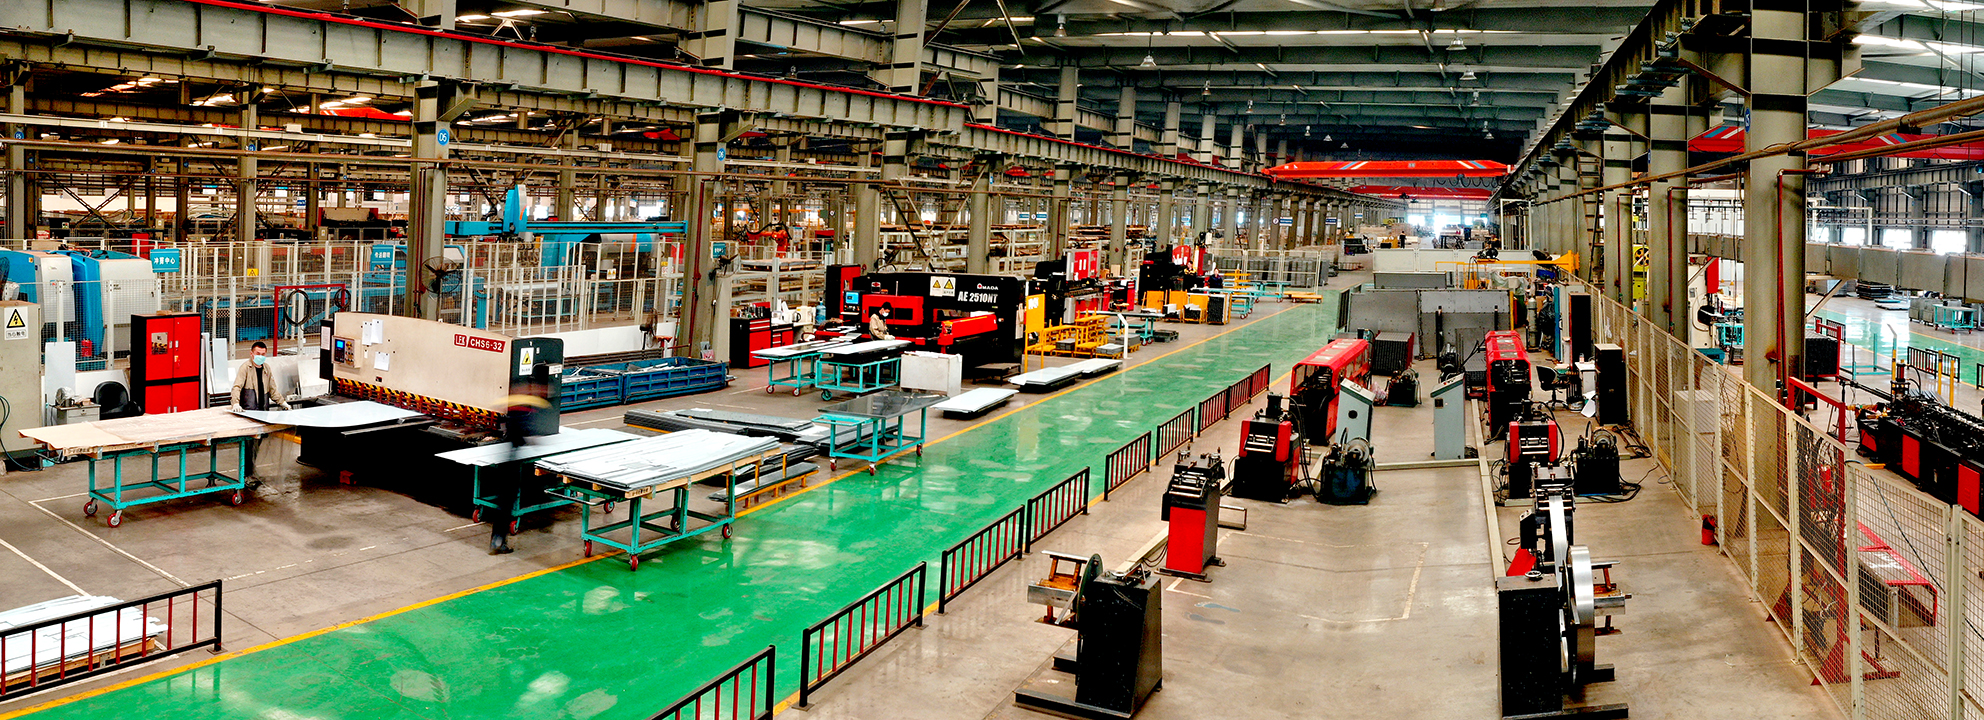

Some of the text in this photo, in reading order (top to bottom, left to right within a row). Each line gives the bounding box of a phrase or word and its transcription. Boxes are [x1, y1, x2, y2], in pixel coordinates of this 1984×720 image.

[957, 291, 998, 304] AE 2510NT
[470, 338, 503, 351] CHS6-32
